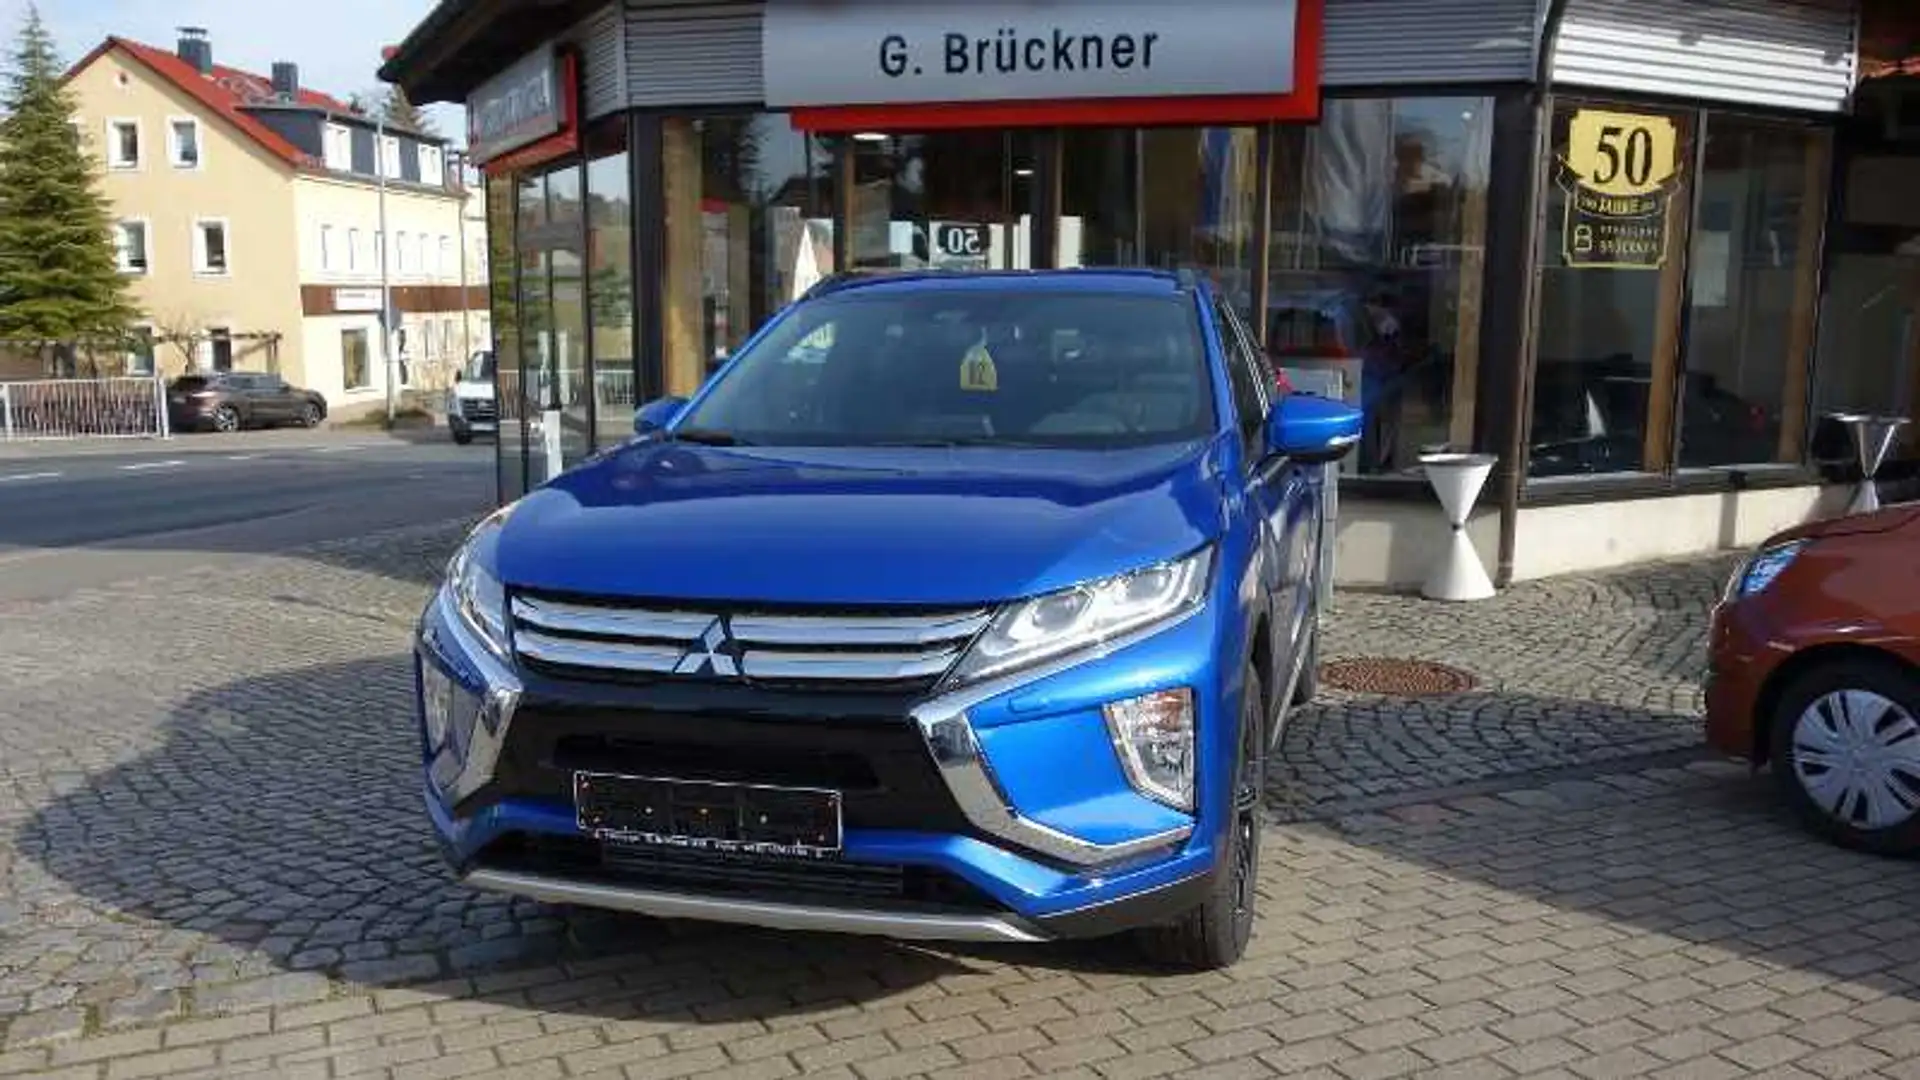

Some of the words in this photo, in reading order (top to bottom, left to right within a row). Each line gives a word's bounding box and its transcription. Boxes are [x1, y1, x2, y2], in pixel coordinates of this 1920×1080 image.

[879, 34, 922, 77] G.
[944, 28, 1159, 74] Brückner
[1593, 126, 1653, 187] 50
